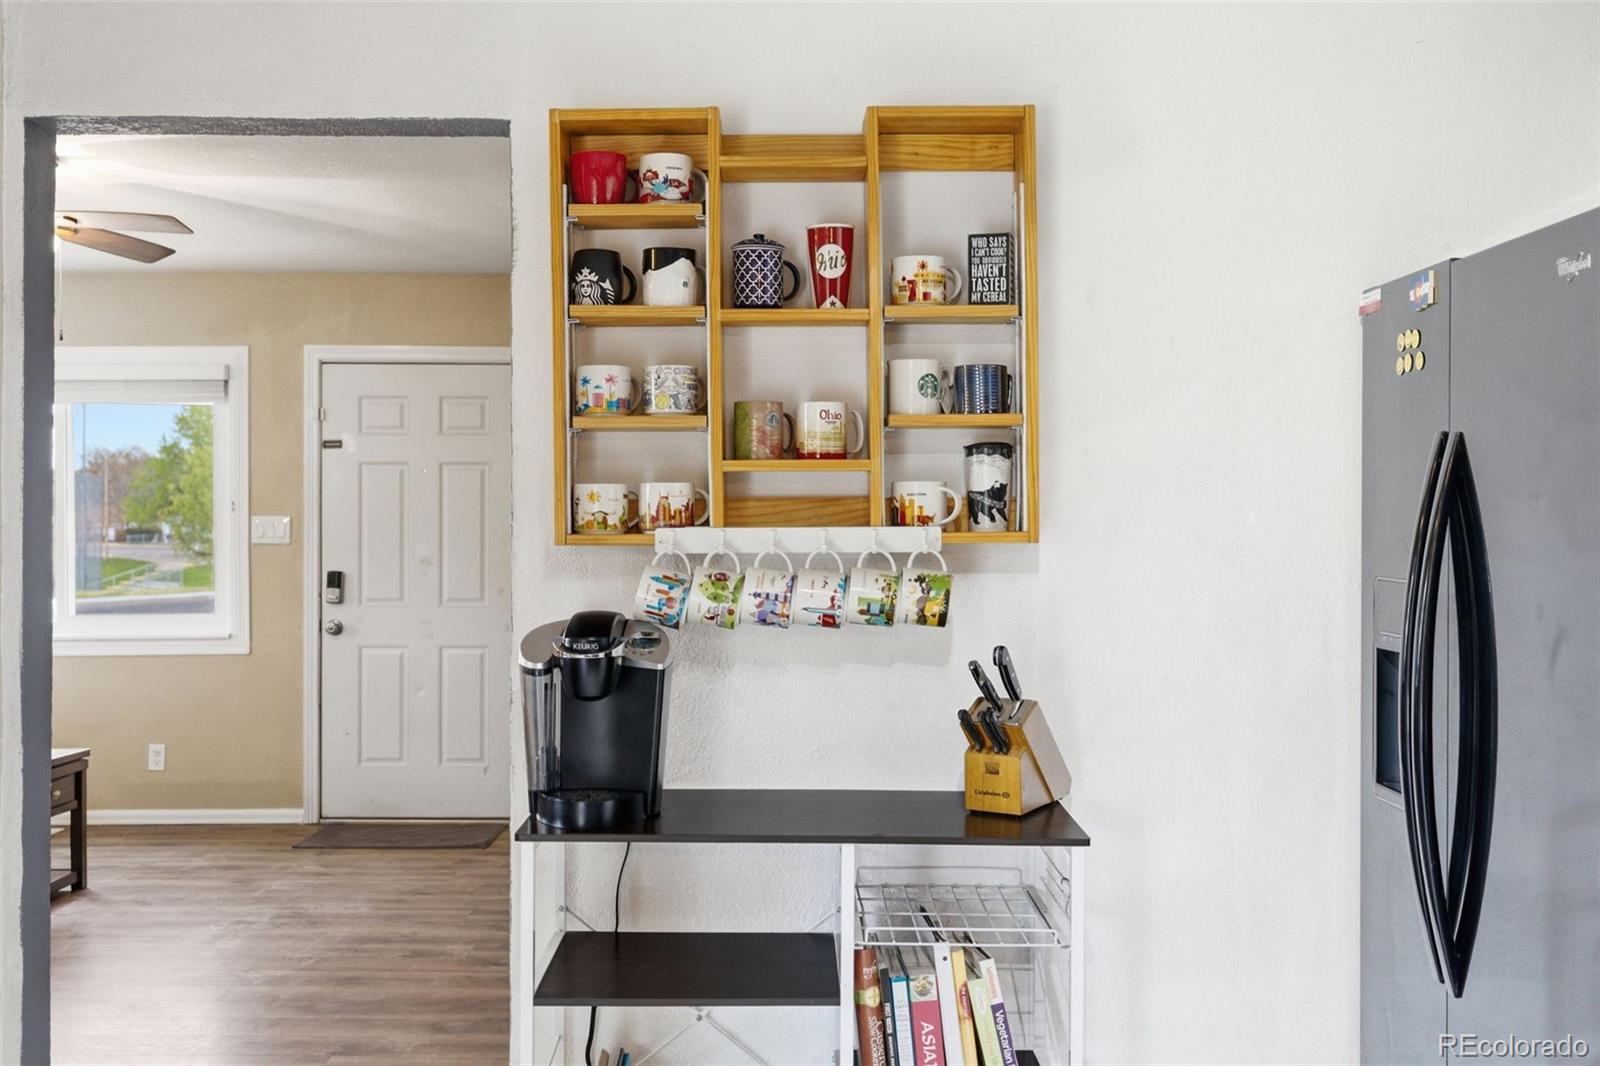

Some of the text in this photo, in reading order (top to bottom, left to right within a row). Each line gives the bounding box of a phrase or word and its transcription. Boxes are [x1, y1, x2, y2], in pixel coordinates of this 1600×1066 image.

[971, 236, 1006, 248] WHO SAYS
[975, 248, 990, 256] CAN'T
[990, 248, 1007, 256] COOK?
[972, 264, 1006, 278] HAVEN'T
[972, 277, 1006, 292] TASTED
[972, 291, 1006, 303] MY CEREAL
[819, 409, 842, 420] Ohio
[572, 642, 599, 650] KEURIG
[996, 1009, 1013, 1064] Vegetarian
